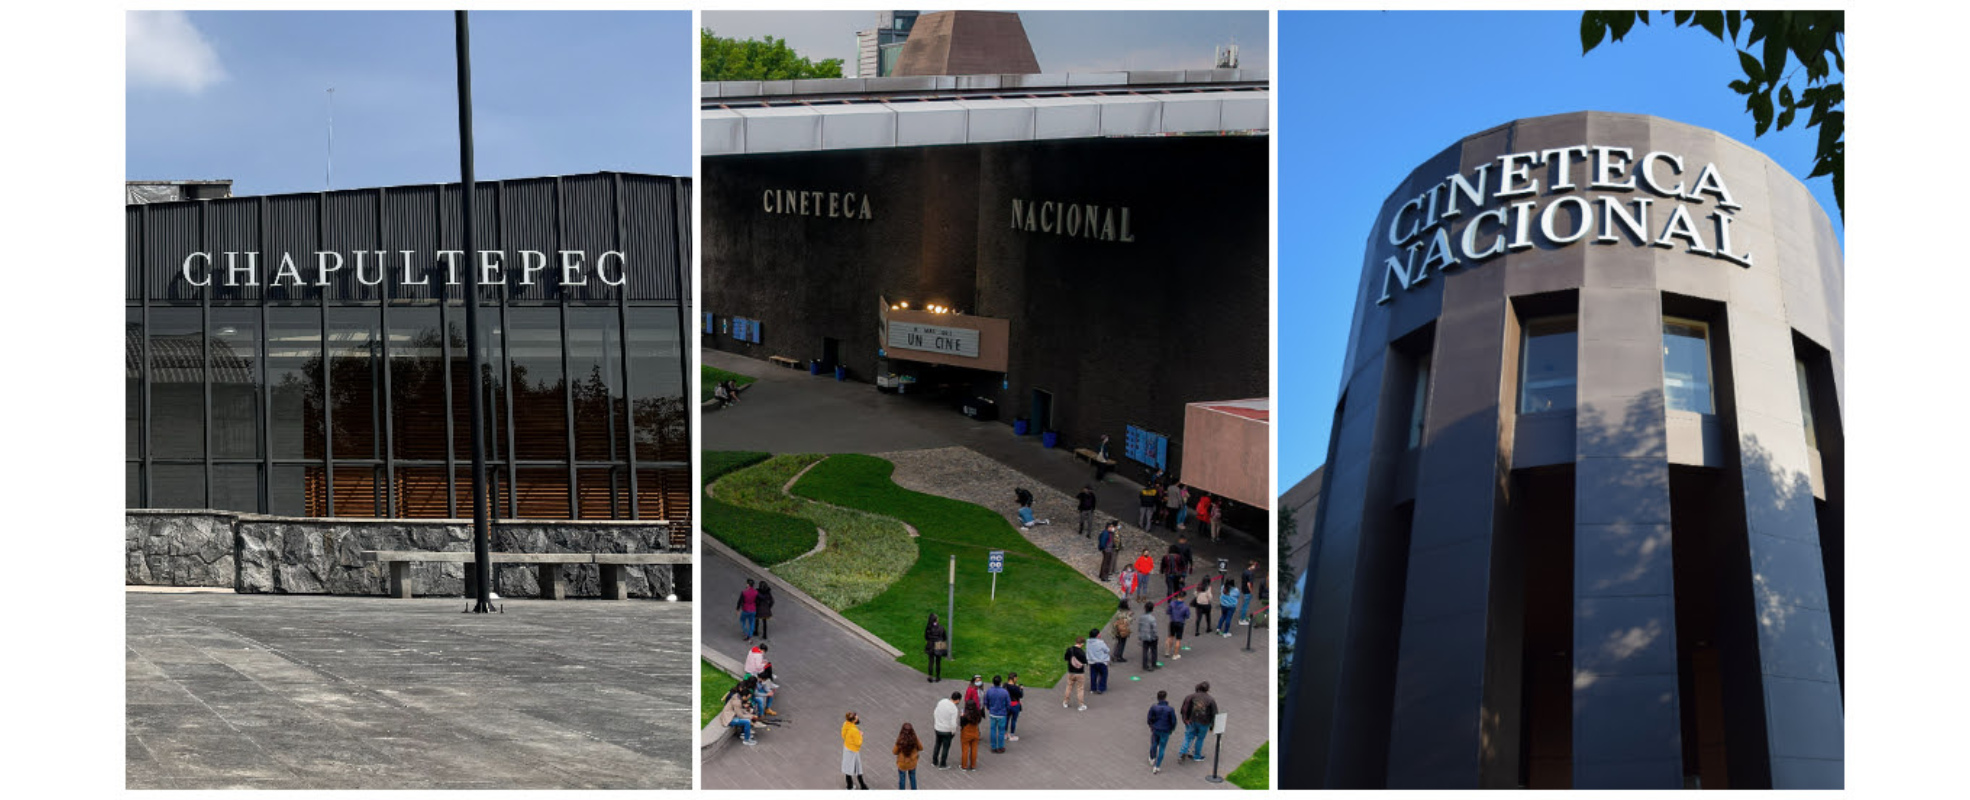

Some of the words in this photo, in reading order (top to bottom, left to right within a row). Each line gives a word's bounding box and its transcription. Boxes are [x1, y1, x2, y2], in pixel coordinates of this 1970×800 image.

[762, 188, 873, 220] CINETECA
[1010, 198, 1136, 243] NACIONAL
[1389, 144, 1743, 247] CINETECA
[182, 250, 627, 288] CHAPULTEPEC
[1376, 195, 1753, 305] NACIONAL
[907, 333, 923, 347] UN
[935, 337, 961, 351] CINE
